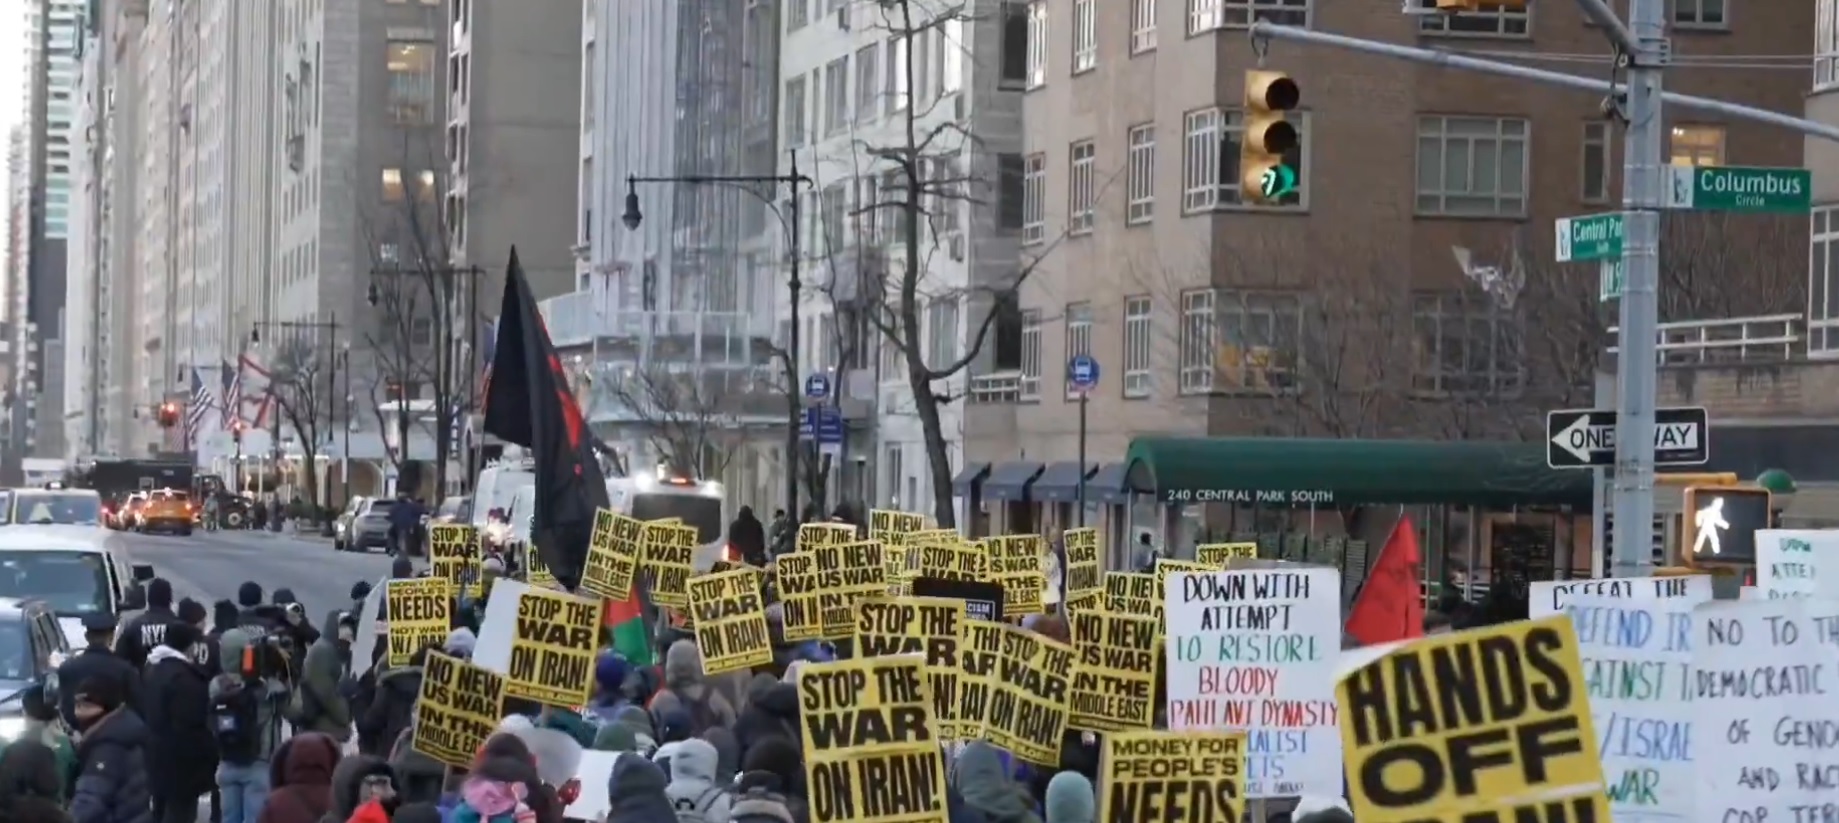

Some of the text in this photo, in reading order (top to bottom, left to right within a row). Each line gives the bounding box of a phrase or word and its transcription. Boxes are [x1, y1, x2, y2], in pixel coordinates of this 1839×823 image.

[1700, 169, 1802, 195] Columbus
[1735, 195, 1766, 207] Circle
[1573, 221, 1608, 243] Central
[1570, 424, 1692, 449] ONE AY
[1168, 489, 1334, 502] 240 CENTRAL PARK SOUTH
[432, 527, 458, 543] STOP
[598, 510, 641, 542] NO NEW
[800, 527, 828, 544] STOP
[871, 512, 923, 532] NO NEW
[606, 536, 637, 558] WAR
[646, 526, 694, 547] STOP THE
[1006, 537, 1037, 558] NEW
[604, 554, 632, 573] THE
[646, 546, 692, 565] WAR
[816, 547, 838, 571] NO
[843, 543, 882, 567] NEW
[922, 546, 954, 570] STOP
[957, 550, 978, 572] THE
[1005, 558, 1039, 572] WAR
[690, 580, 726, 603] STOP
[726, 572, 755, 596] THE
[818, 568, 884, 588] US WAR
[1004, 576, 1040, 589] THE
[1106, 576, 1127, 598] NO
[1130, 578, 1154, 600] NE
[1183, 574, 1310, 604] DOWN WITH
[390, 596, 446, 622] NEEDS
[518, 594, 597, 628] STOP THE
[694, 594, 761, 622] WAR
[859, 602, 958, 636] STOP THE
[1128, 600, 1151, 616] WA
[1200, 604, 1296, 632] ATTEMPT
[518, 618, 593, 650] WAR
[698, 618, 768, 659] ON IRAN!
[1076, 612, 1155, 650] NO NEW
[1707, 618, 1744, 646] NO
[1763, 616, 1798, 646] TO
[510, 644, 590, 692] ON IRAN!
[963, 652, 997, 676] AR
[1003, 631, 1073, 679] STOP THE
[1104, 649, 1152, 673] WAR
[426, 655, 453, 686] NO
[457, 664, 503, 703] NEW
[802, 668, 866, 711] STOP
[872, 666, 924, 705] THE
[1000, 657, 1067, 704] WAR
[1072, 671, 1150, 698] IN THE
[1198, 666, 1280, 697] BLOODY
[1346, 626, 1573, 748] HANDS
[1696, 662, 1827, 700] DEMOCRATIC
[424, 681, 450, 706] US
[452, 692, 498, 721] WAR
[990, 688, 1016, 732] ON
[1070, 692, 1148, 720] MIDDLE EAST
[1262, 700, 1339, 728] DYNASTY
[419, 706, 444, 726] IN
[806, 706, 930, 750] WAR
[417, 722, 460, 750] MIDDLE
[1727, 718, 1751, 745] OF
[1112, 738, 1238, 756] MONEY FOR
[1112, 757, 1239, 778] PEOPLE'S
[1359, 714, 1584, 809] OFF
[812, 752, 941, 822] ON IRAN!
[1606, 770, 1662, 806] WAR
[1738, 766, 1780, 792] AND
[1108, 778, 1238, 823] NEEDS
